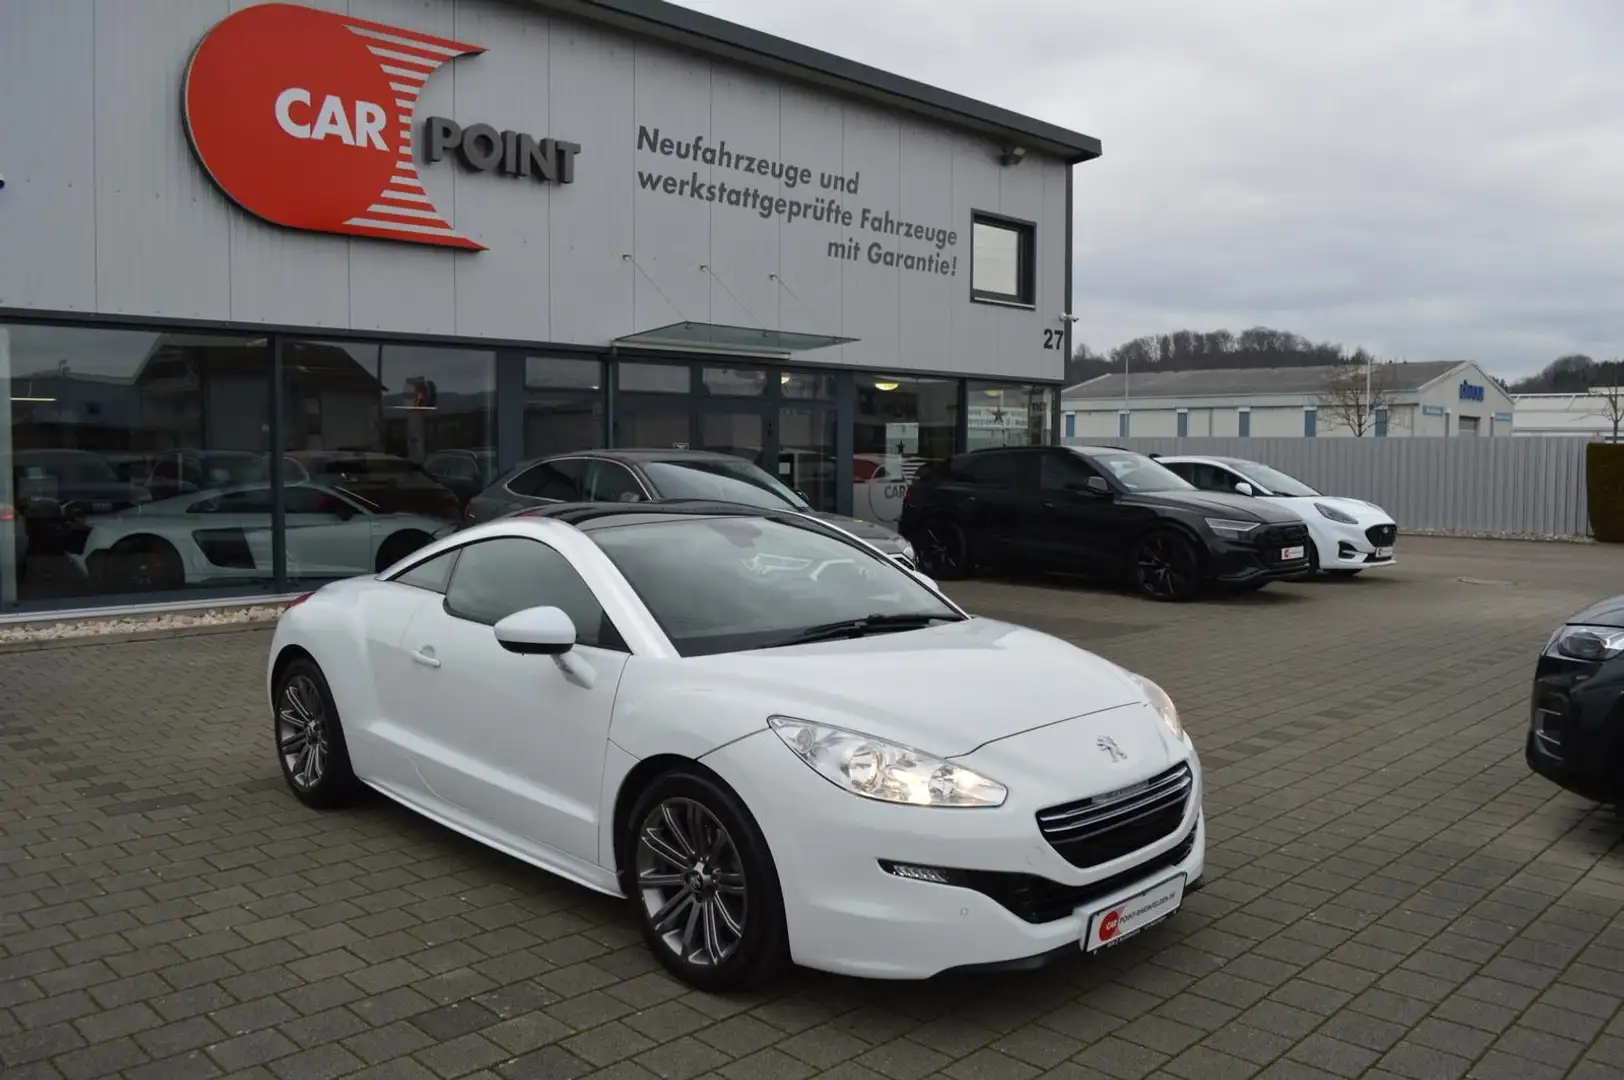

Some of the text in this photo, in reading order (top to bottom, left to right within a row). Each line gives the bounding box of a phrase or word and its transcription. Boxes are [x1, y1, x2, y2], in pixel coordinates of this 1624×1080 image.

[275, 87, 582, 184] CAR POINT
[637, 125, 860, 194] Neufahrzeuge und
[637, 171, 958, 250] werkstattgeprüfte Fahrzeuge
[827, 237, 957, 276] mit Garantie!
[1043, 328, 1064, 350] 27
